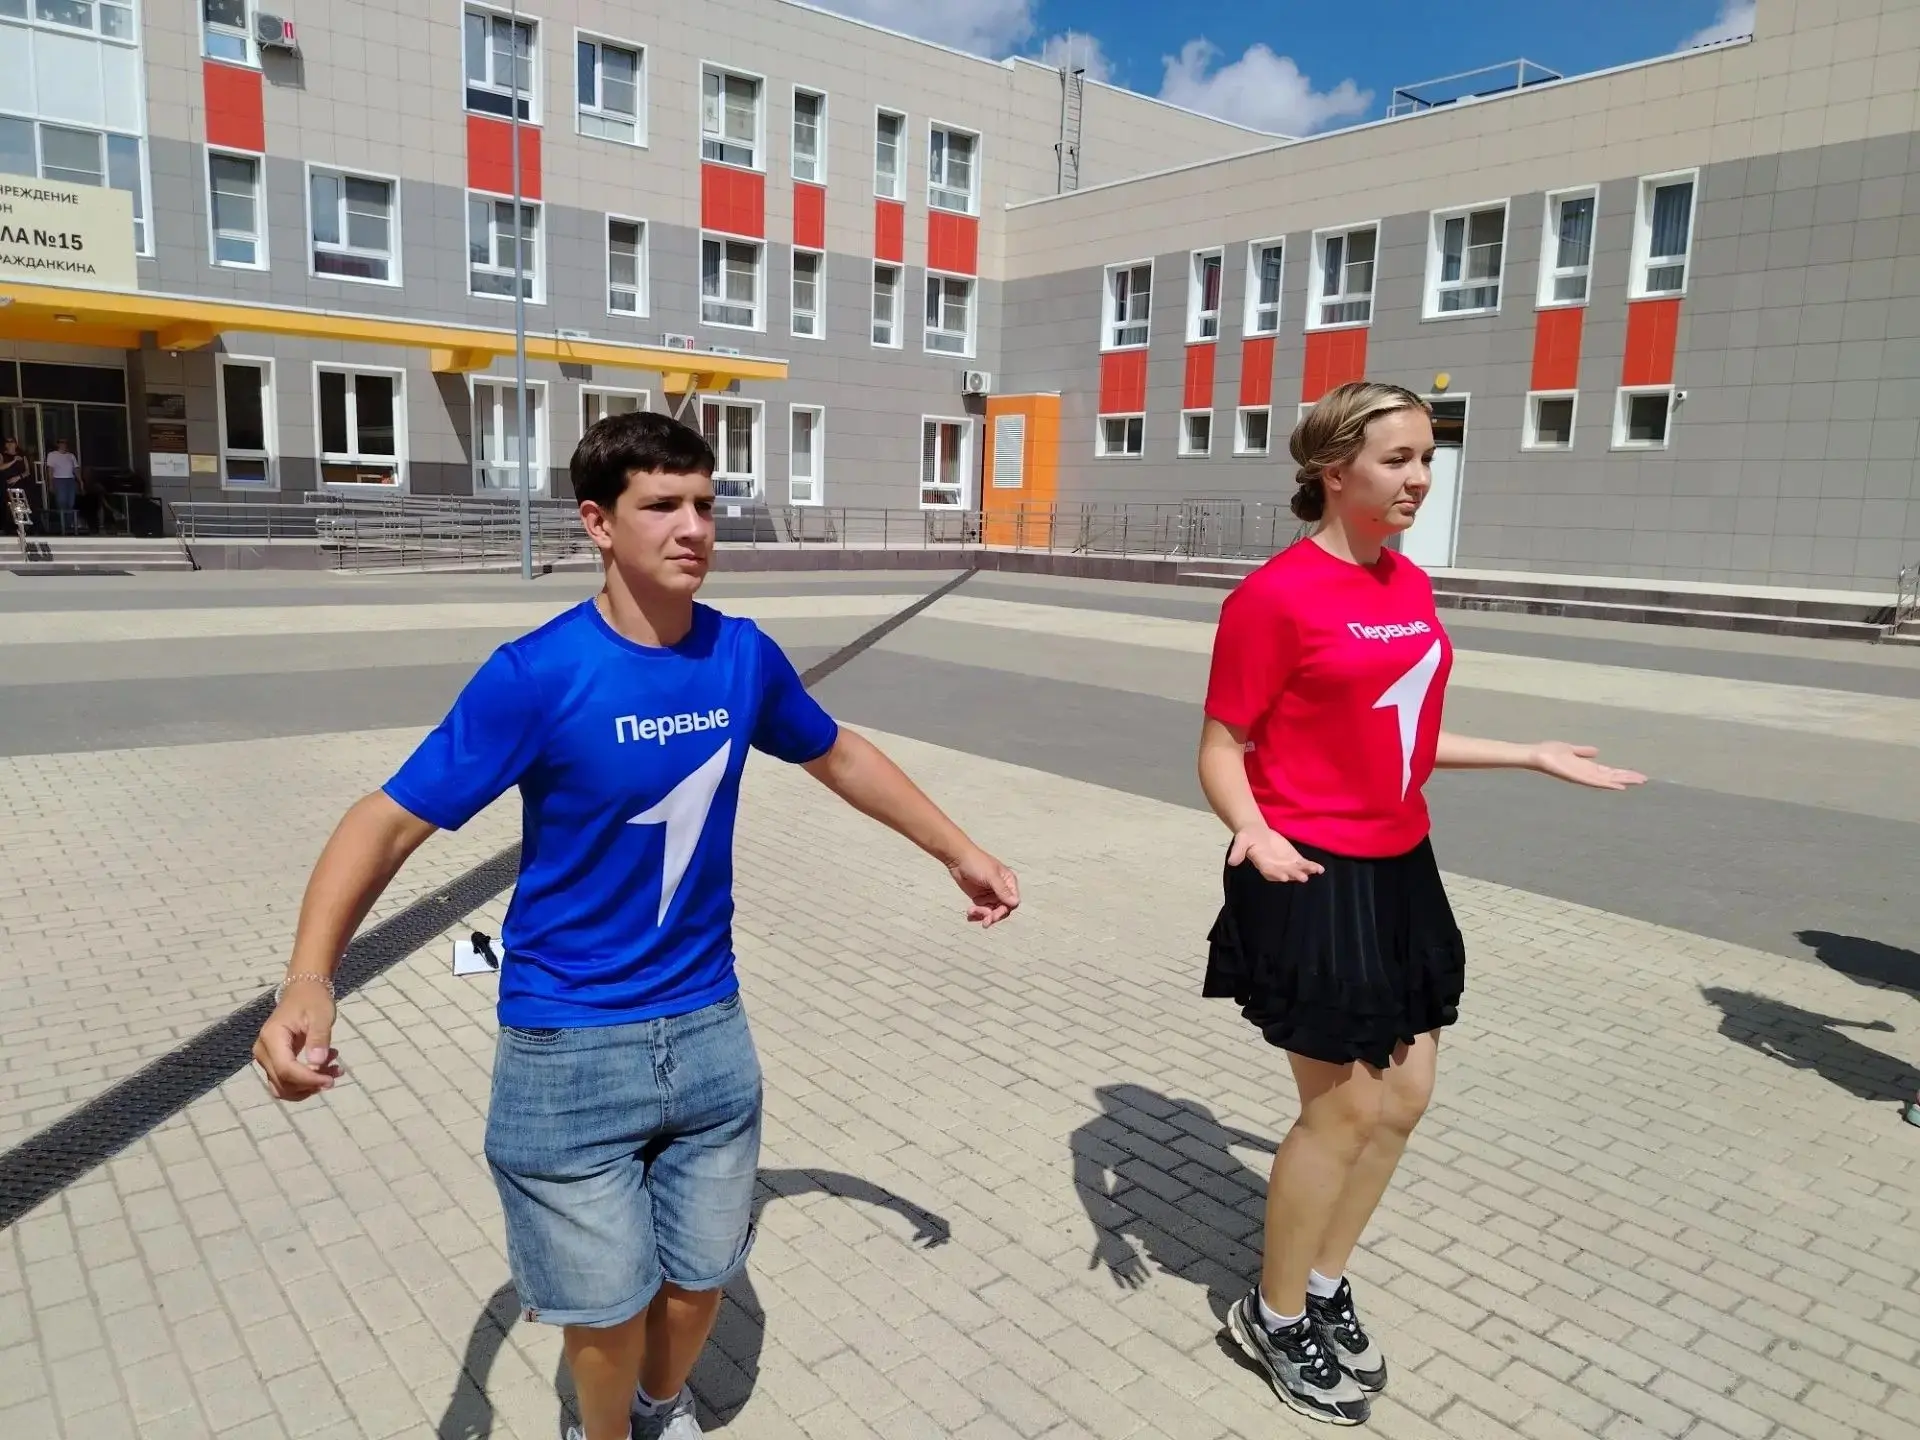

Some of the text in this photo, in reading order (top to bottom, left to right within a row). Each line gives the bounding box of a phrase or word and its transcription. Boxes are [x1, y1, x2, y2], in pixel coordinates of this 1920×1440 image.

[0, 225, 84, 251] ЛА №15
[0, 254, 96, 274] АЖДАНКИНА
[1347, 621, 1431, 644] Первые
[615, 708, 730, 746] Первые
